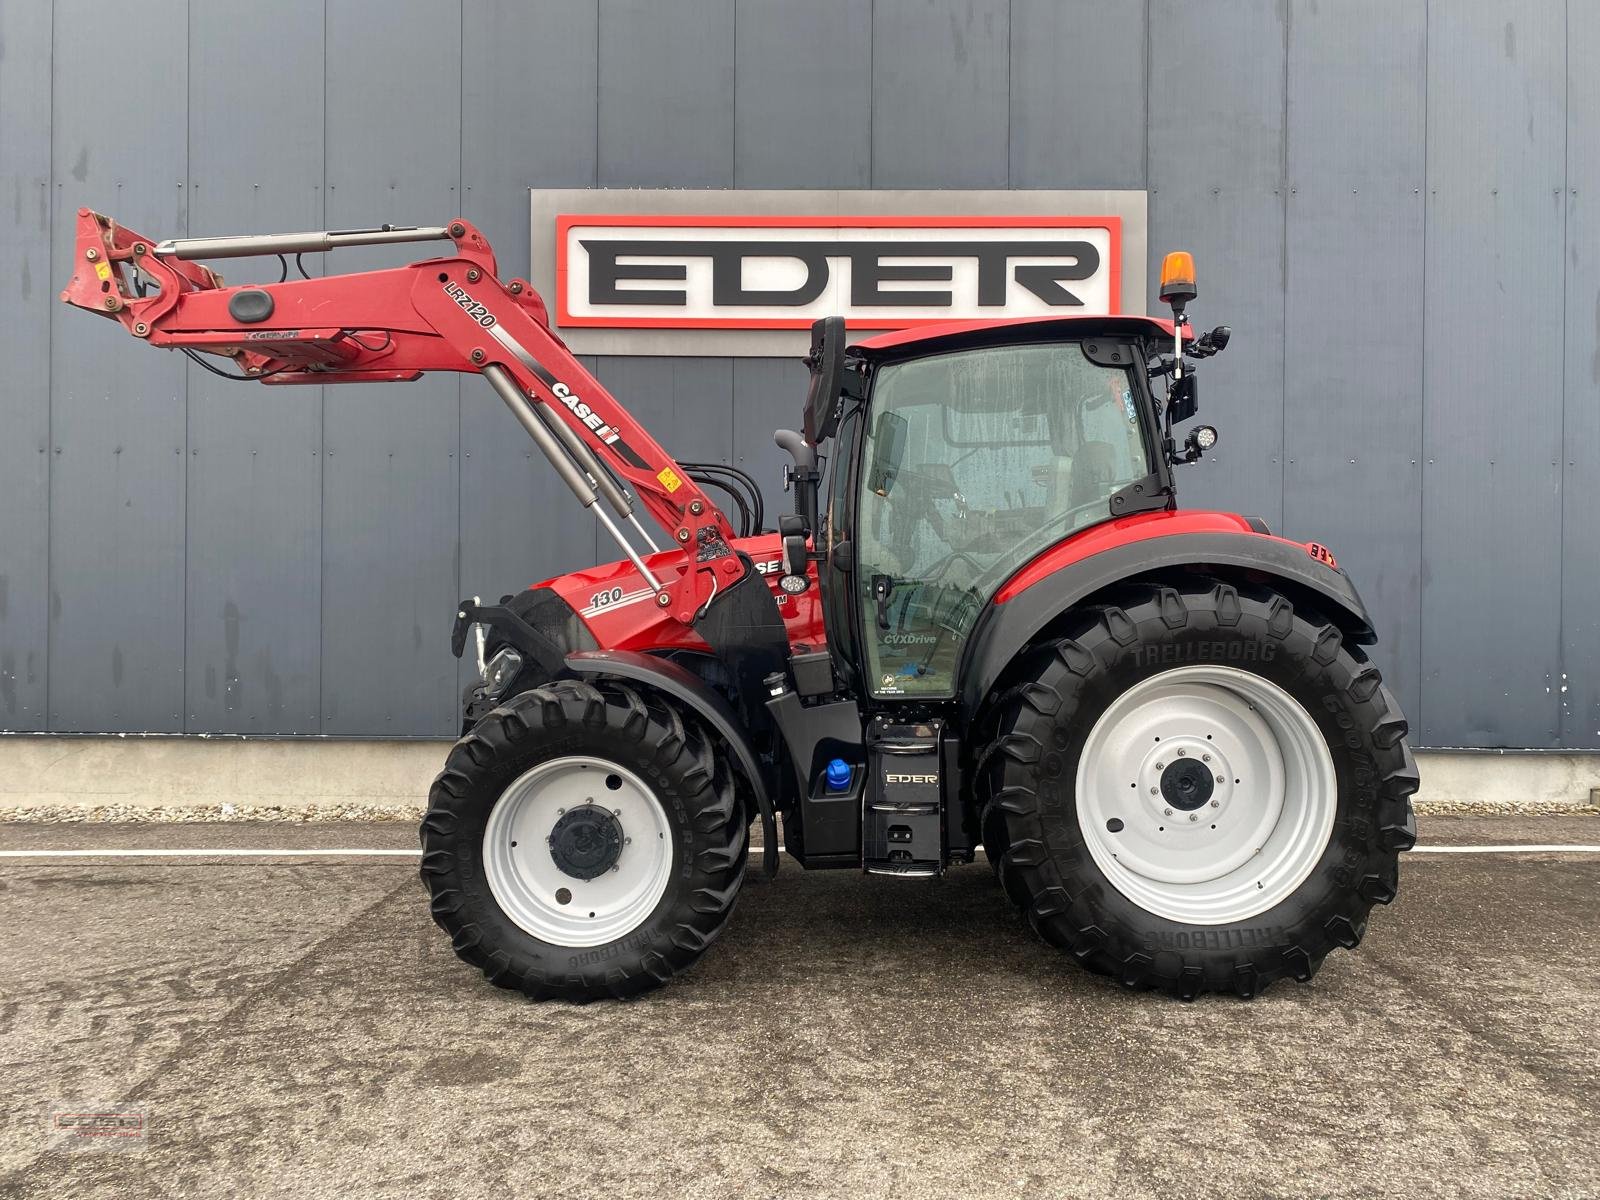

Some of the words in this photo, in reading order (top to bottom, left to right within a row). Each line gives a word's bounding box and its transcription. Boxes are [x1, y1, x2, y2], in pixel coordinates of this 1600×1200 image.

[578, 240, 1101, 306] EDER
[443, 281, 497, 328] LRZ120
[552, 382, 605, 430] CASE
[755, 560, 780, 575] SE
[590, 587, 623, 609] 130
[884, 633, 937, 644] CVXDrive
[1128, 639, 1277, 667] TRELLEBORG
[886, 774, 938, 783] EDER
